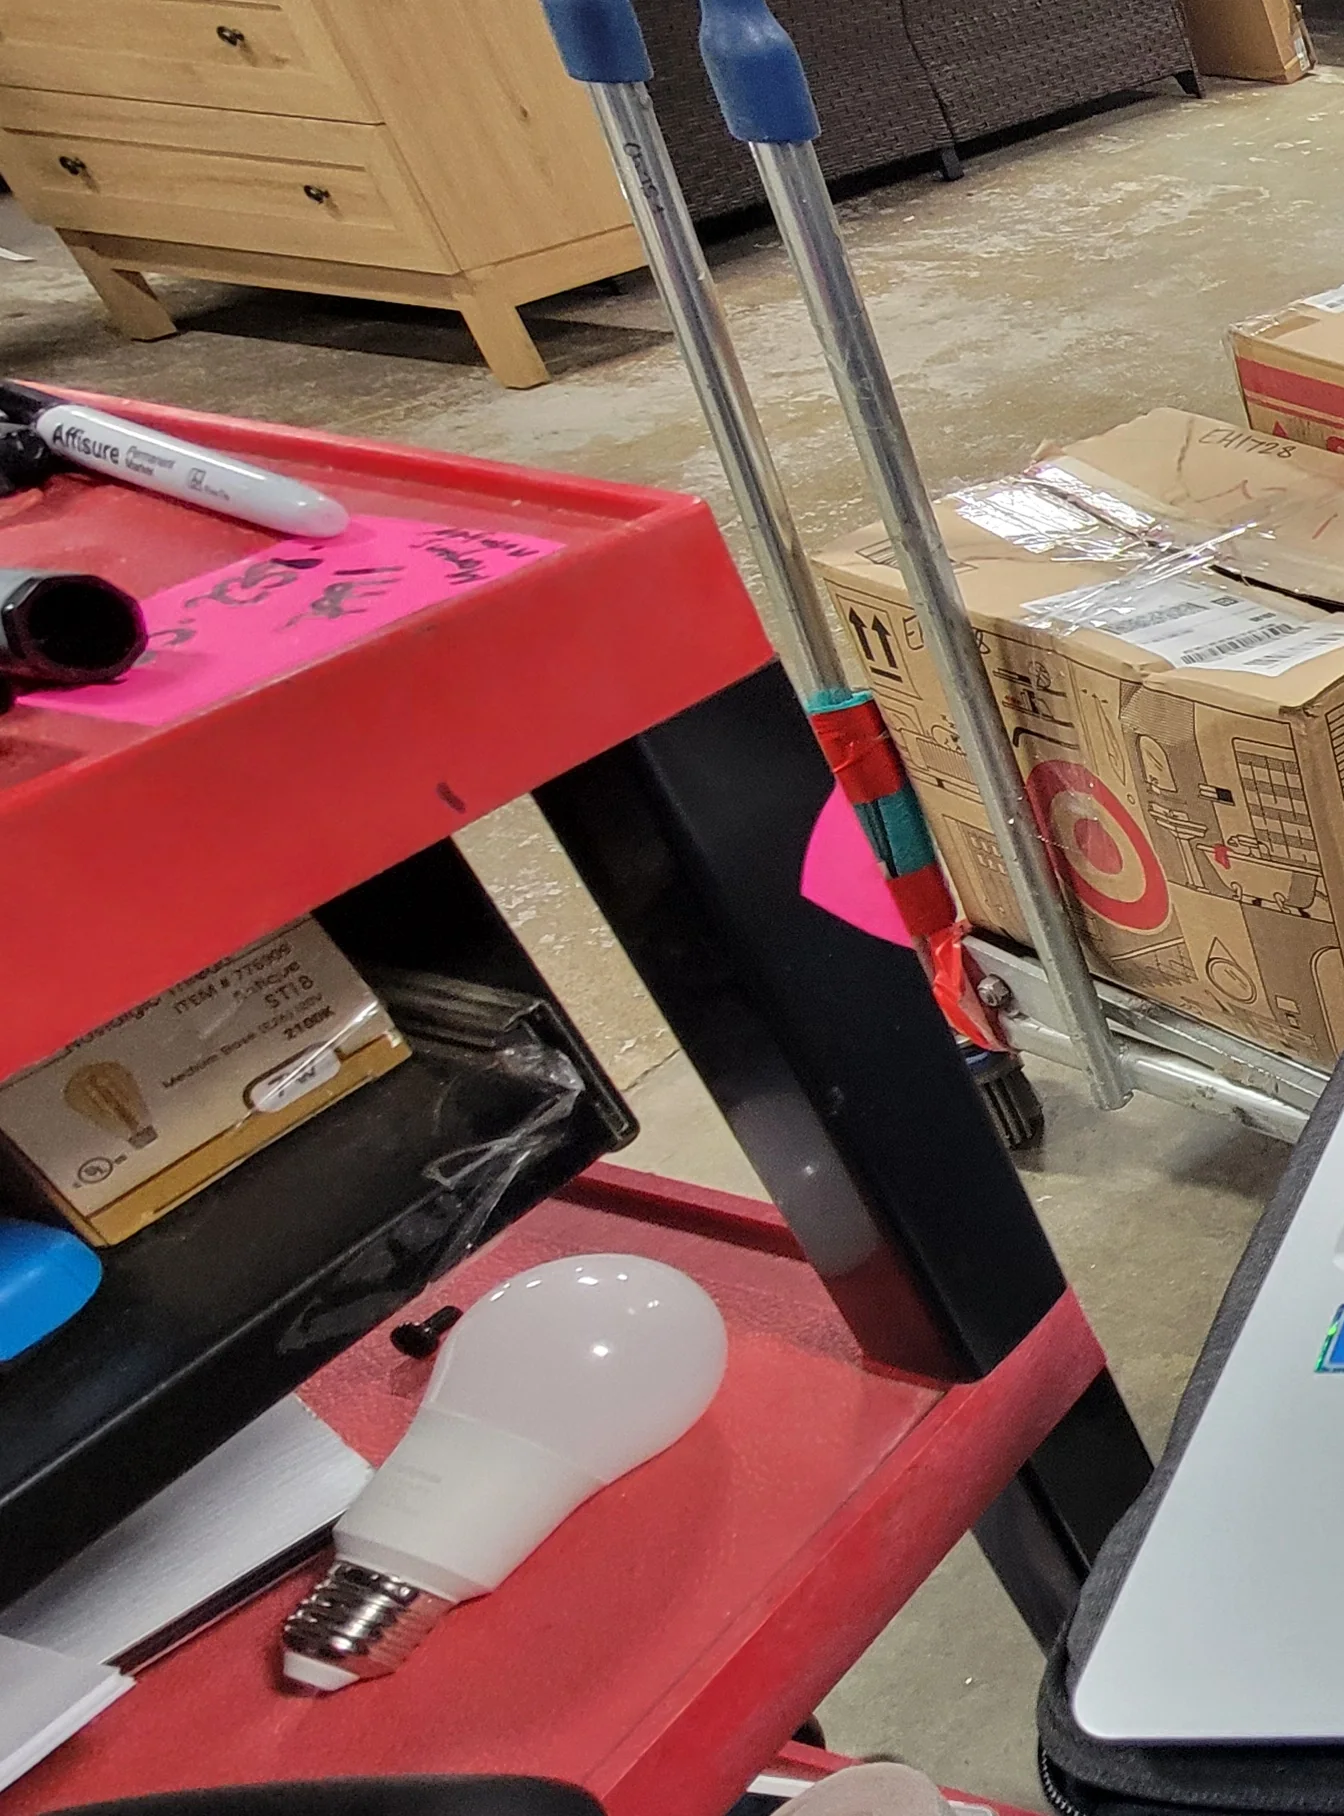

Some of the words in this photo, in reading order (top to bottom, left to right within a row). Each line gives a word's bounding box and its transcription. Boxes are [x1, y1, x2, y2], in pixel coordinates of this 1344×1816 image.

[53, 423, 120, 465] Affisure
[1198, 428, 1297, 459] EH1728
[172, 984, 219, 1015] ITEM
[264, 975, 315, 1009] ST18
